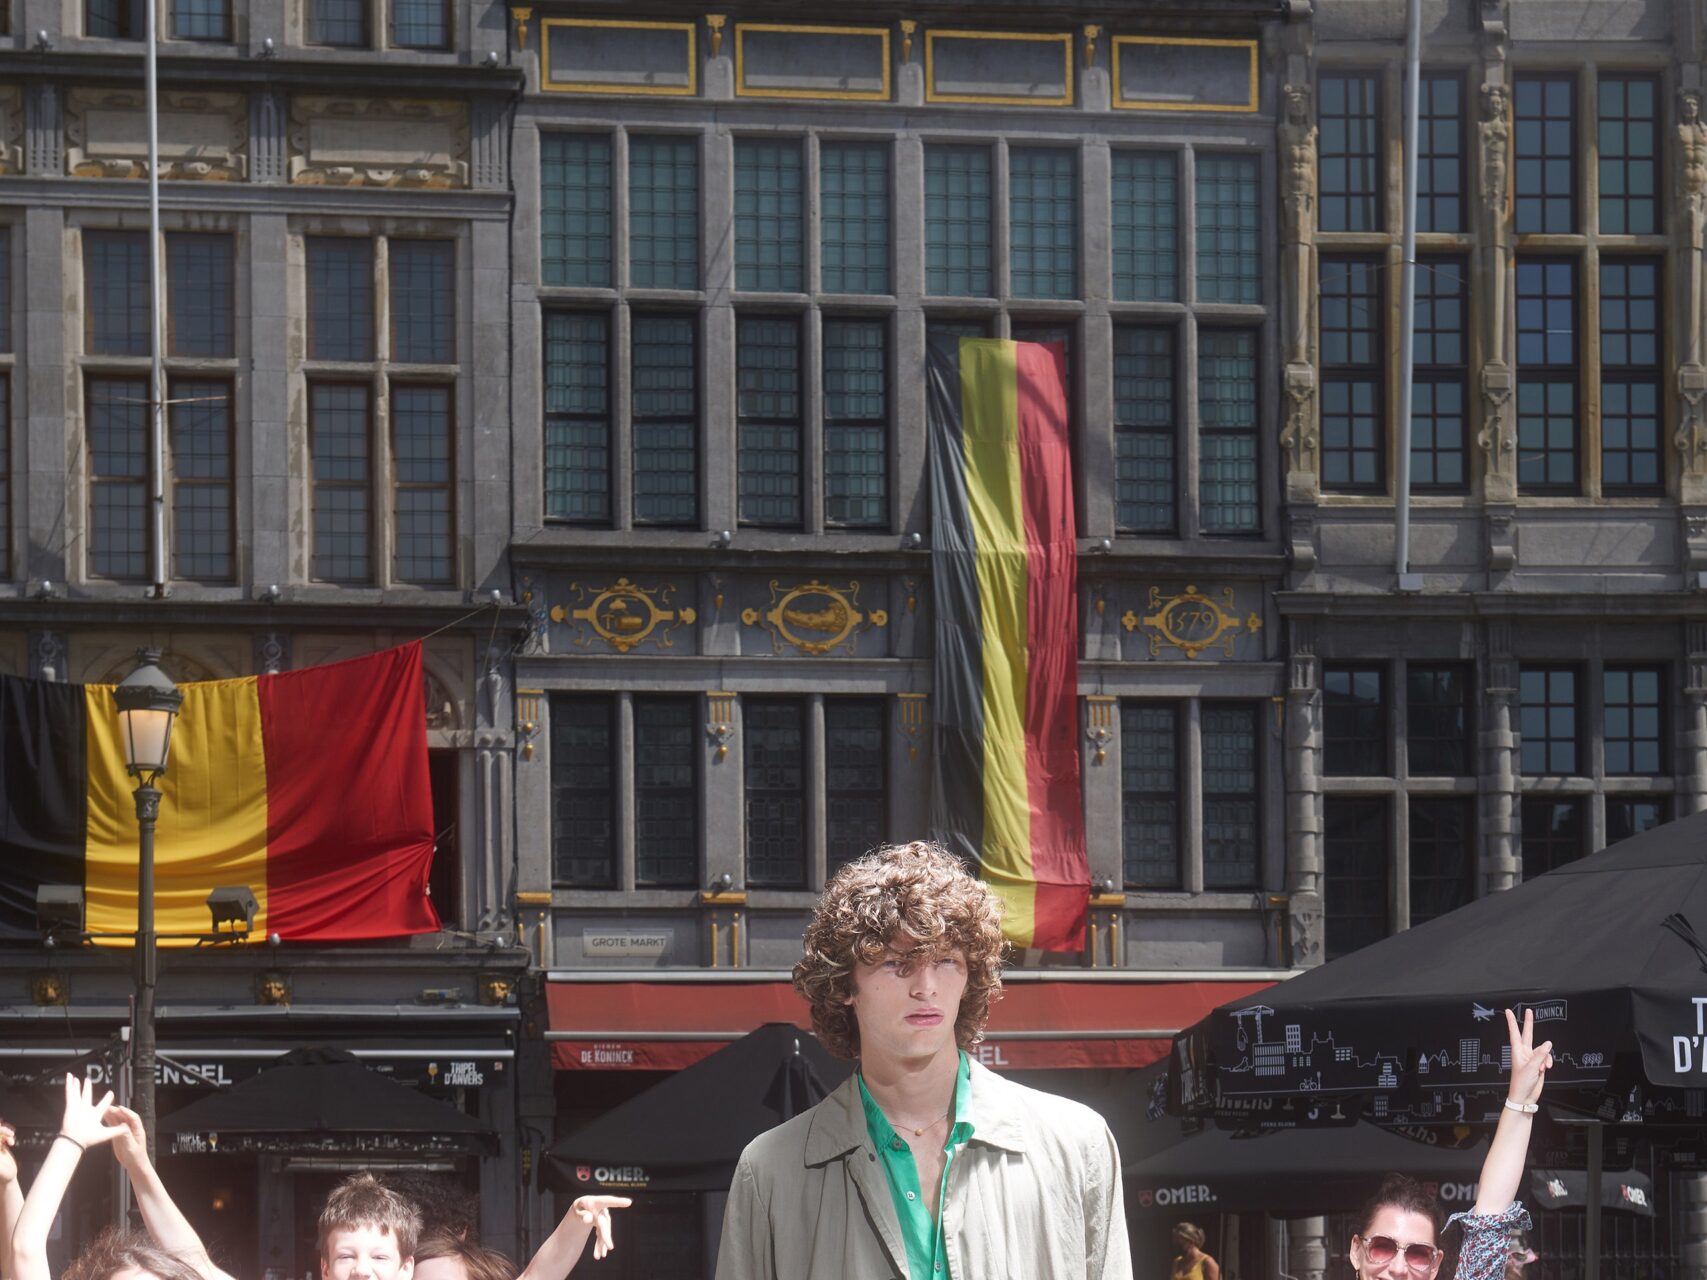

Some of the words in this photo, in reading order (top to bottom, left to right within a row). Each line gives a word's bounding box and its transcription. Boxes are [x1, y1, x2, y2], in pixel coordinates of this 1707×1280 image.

[592, 938, 627, 947] GROTE
[630, 938, 665, 947] MARKT
[1535, 1006, 1564, 1019] KONINCK
[581, 1051, 592, 1063] DE
[595, 1050, 633, 1063] KONINCK
